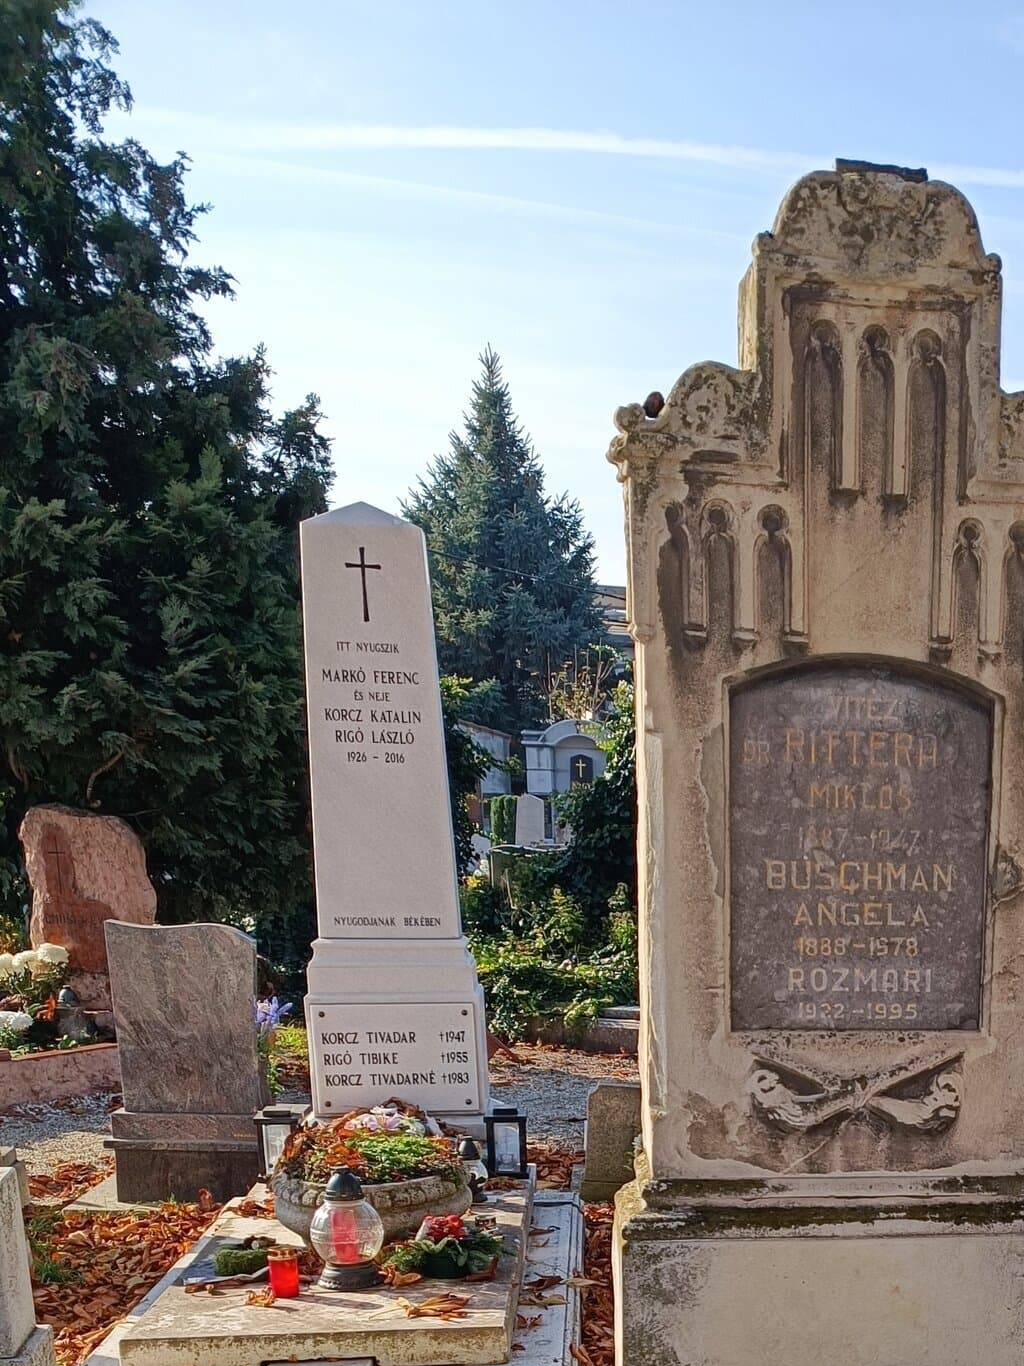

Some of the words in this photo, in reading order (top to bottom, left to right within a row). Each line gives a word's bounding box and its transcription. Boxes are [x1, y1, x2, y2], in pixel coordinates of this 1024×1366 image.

[336, 641, 351, 652] ITT
[356, 642, 400, 654] NYUGSZIK
[321, 666, 367, 684] MARKÓ
[373, 670, 420, 685] FERENC
[353, 689, 364, 701] ÉS
[368, 691, 391, 702] NEJE
[324, 708, 363, 722] KORCZ
[370, 709, 422, 724] KATALIN
[335, 726, 364, 743] RIGÓ
[371, 728, 415, 745] LÁSZLÓ
[346, 751, 368, 763] 1926
[384, 752, 406, 764] 2016
[764, 859, 955, 894] BUSCHMAN
[333, 916, 397, 927] NYUGODJANAK
[403, 915, 441, 927] BÉKÉBEN
[786, 966, 933, 994] ROZMARI
[321, 1031, 360, 1045] KORCZ
[366, 1031, 417, 1044] TIVADAR
[323, 1050, 353, 1066] RIGÓ
[359, 1052, 399, 1066] TIBIKE
[325, 1074, 364, 1087] KORCZ
[369, 1070, 437, 1087] TIVADARNÉ
